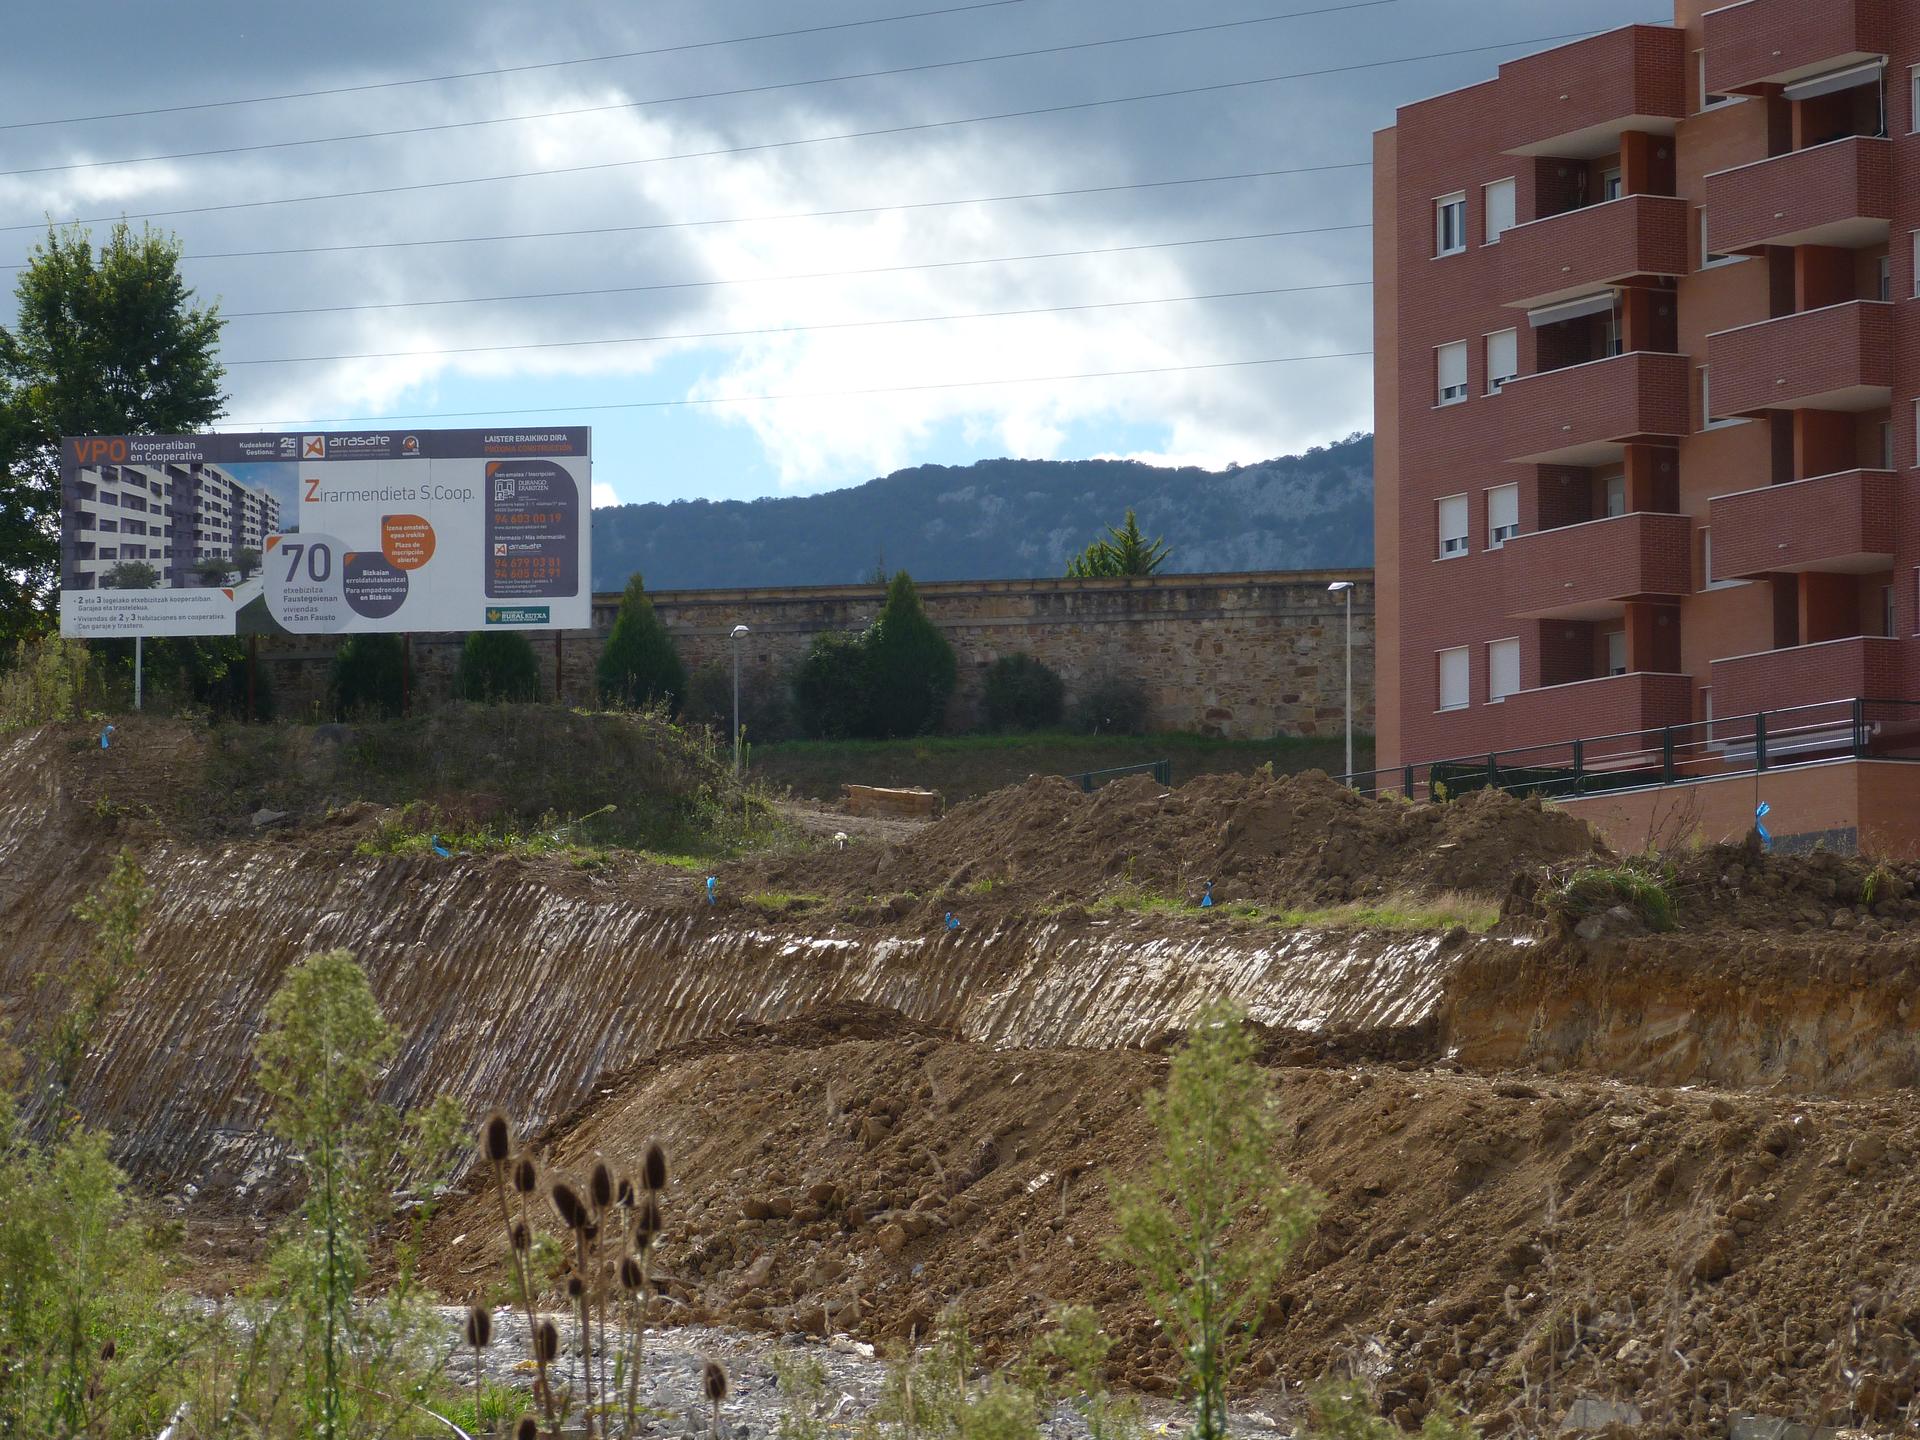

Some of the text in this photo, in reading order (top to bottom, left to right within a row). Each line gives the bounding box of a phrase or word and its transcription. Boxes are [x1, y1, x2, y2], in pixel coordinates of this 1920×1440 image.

[280, 437, 296, 448] 25
[329, 434, 390, 447] arrasate
[484, 435, 514, 443] LAISTER
[516, 434, 548, 442] ERAIKIKO
[73, 438, 127, 464] VPO
[130, 441, 196, 452] Kooperatiban
[145, 452, 203, 462] Cooperativa
[304, 479, 475, 502] Zirarmendieta S.Coop.
[282, 543, 331, 582] 70
[78, 596, 83, 604] 2
[310, 613, 336, 621] Fausto
[91, 623, 111, 631] garaje
